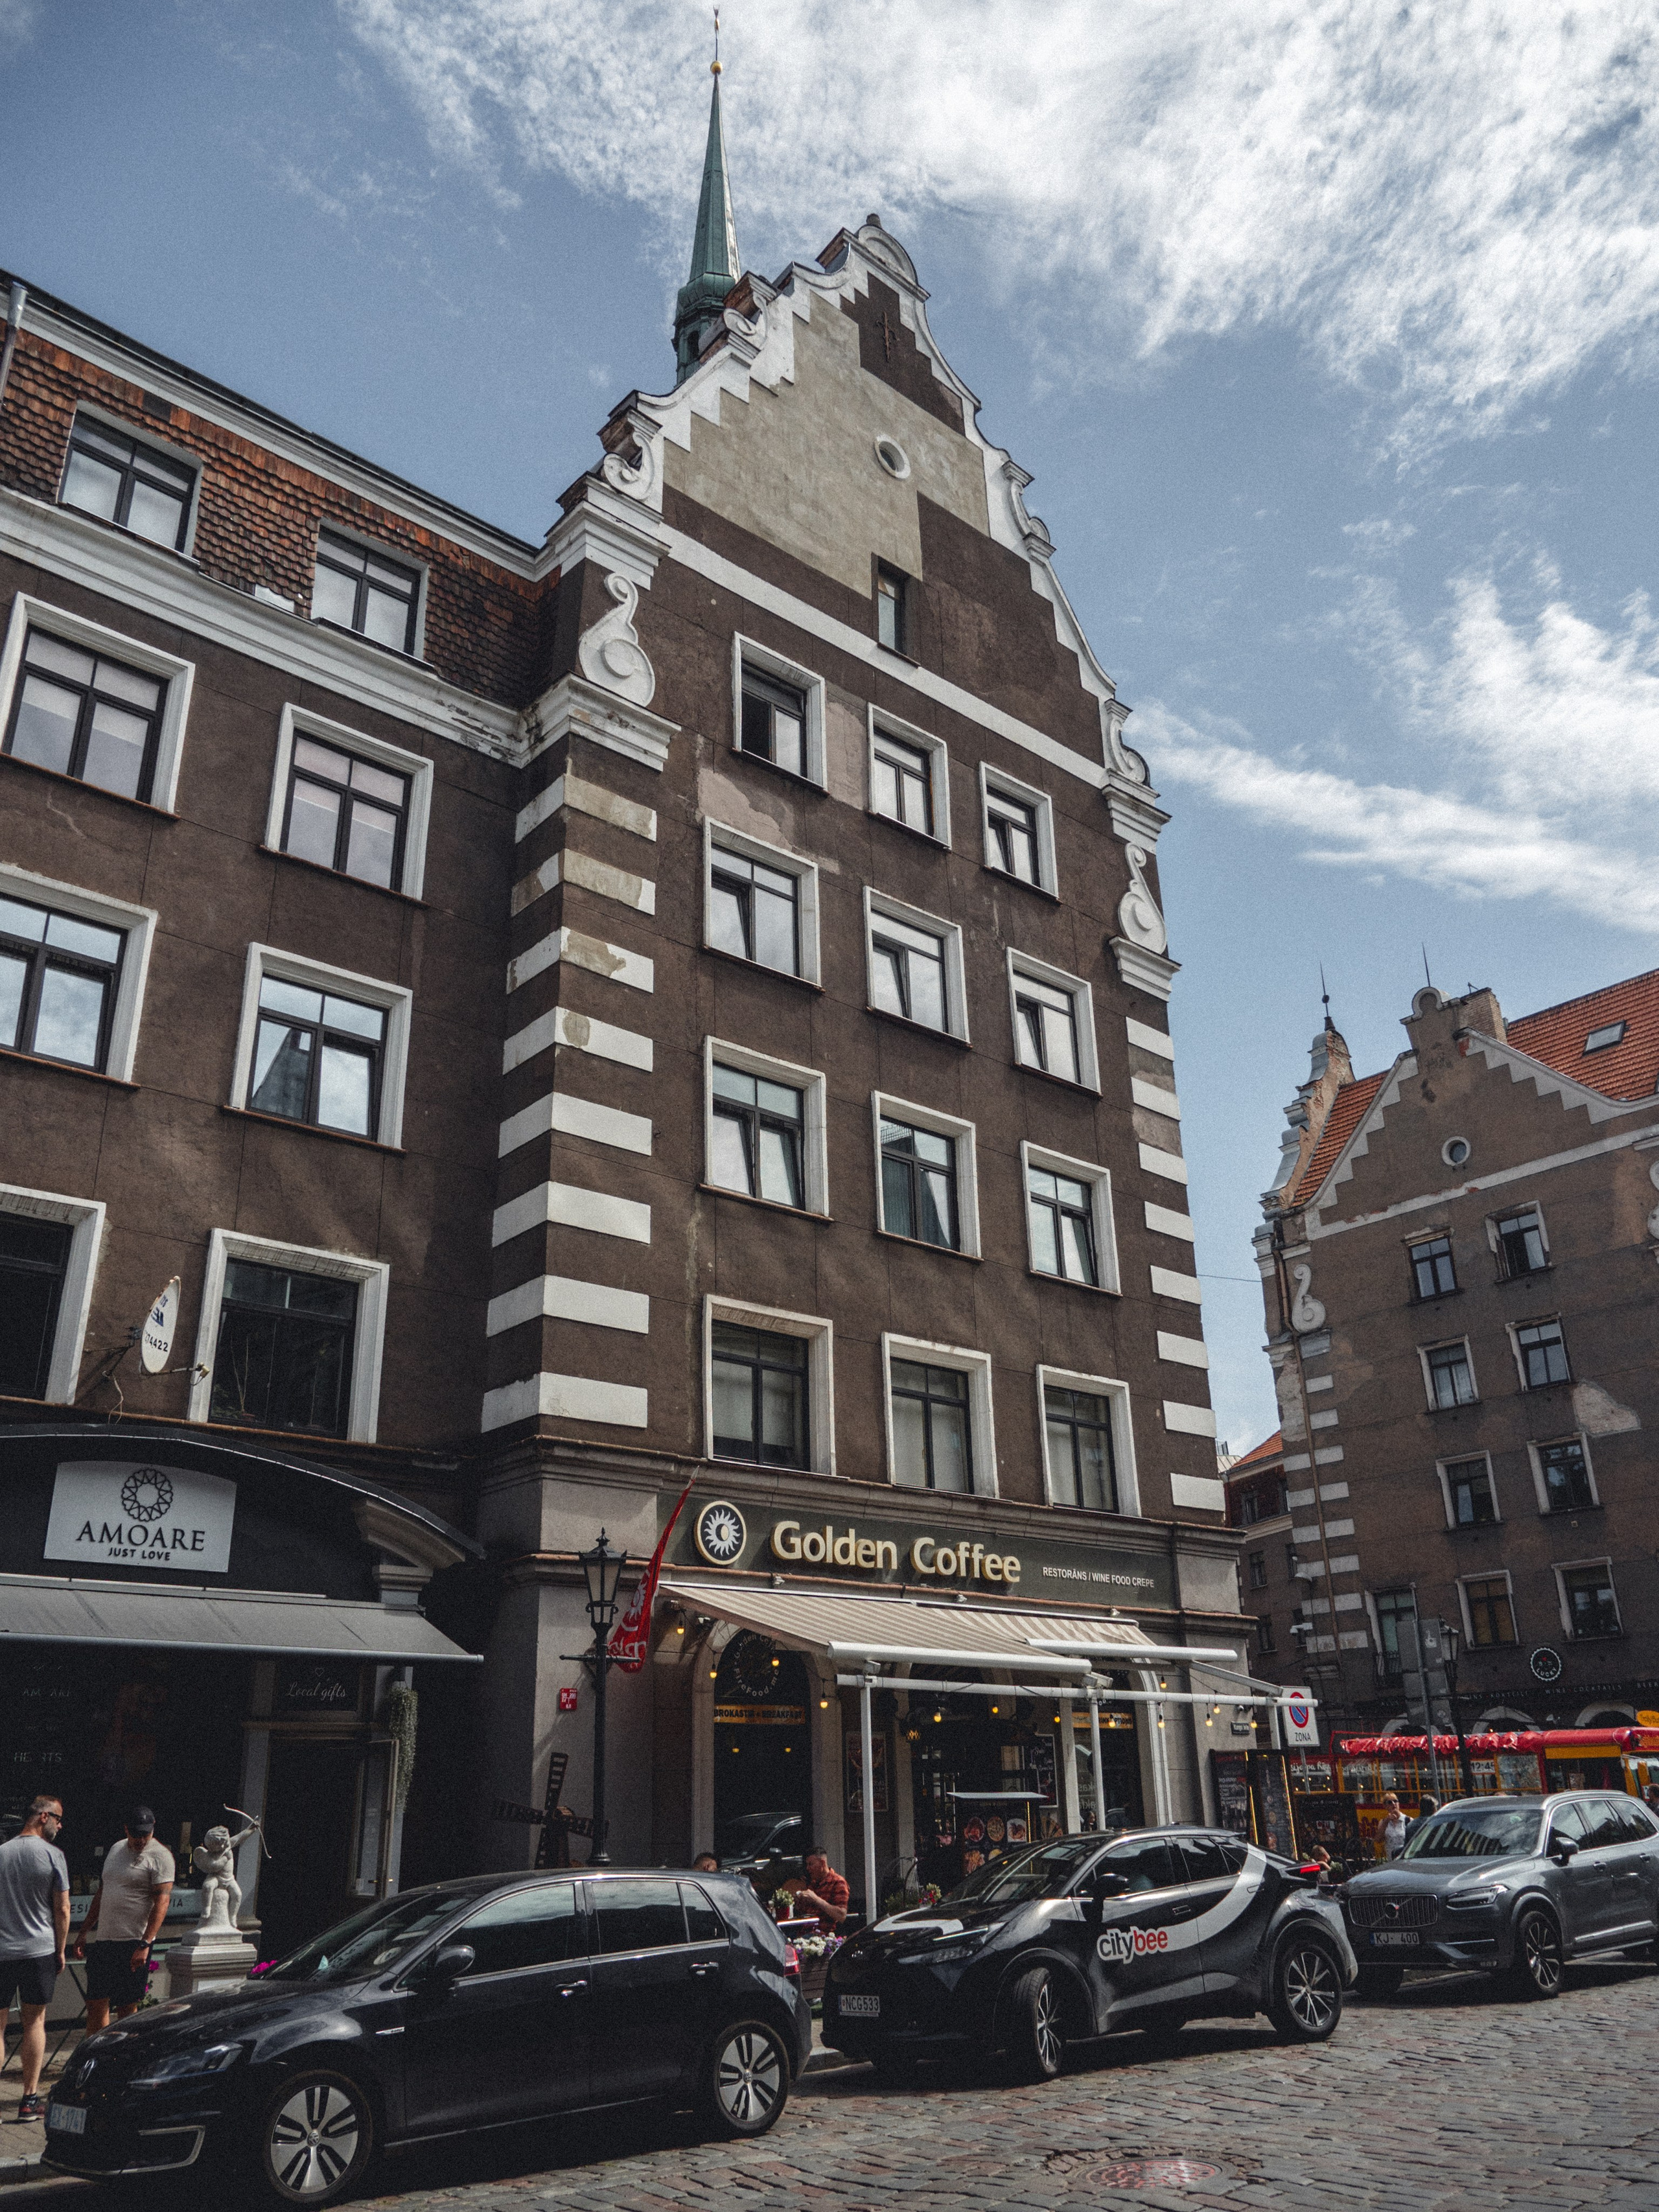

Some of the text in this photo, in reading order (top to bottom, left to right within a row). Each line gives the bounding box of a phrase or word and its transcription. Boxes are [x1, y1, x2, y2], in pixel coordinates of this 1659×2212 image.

[76, 1520, 205, 1551] AMOARE
[108, 1547, 171, 1561] JUST LOVE
[771, 1520, 1021, 1583] Golden Coffee
[1043, 1567, 1087, 1581] RESTORĀNS
[1091, 1572, 1110, 1583] WINE
[1111, 1575, 1131, 1585] FOOD
[1132, 1577, 1154, 1588] CREPE
[1536, 1666, 1557, 1677] LUCKY
[286, 1677, 346, 1702] Local gifts
[1294, 1732, 1312, 1741] ZONA
[1099, 1929, 1168, 1960] citybee
[1400, 1933, 1418, 1944] 400
[846, 1996, 879, 2011] NCG533
